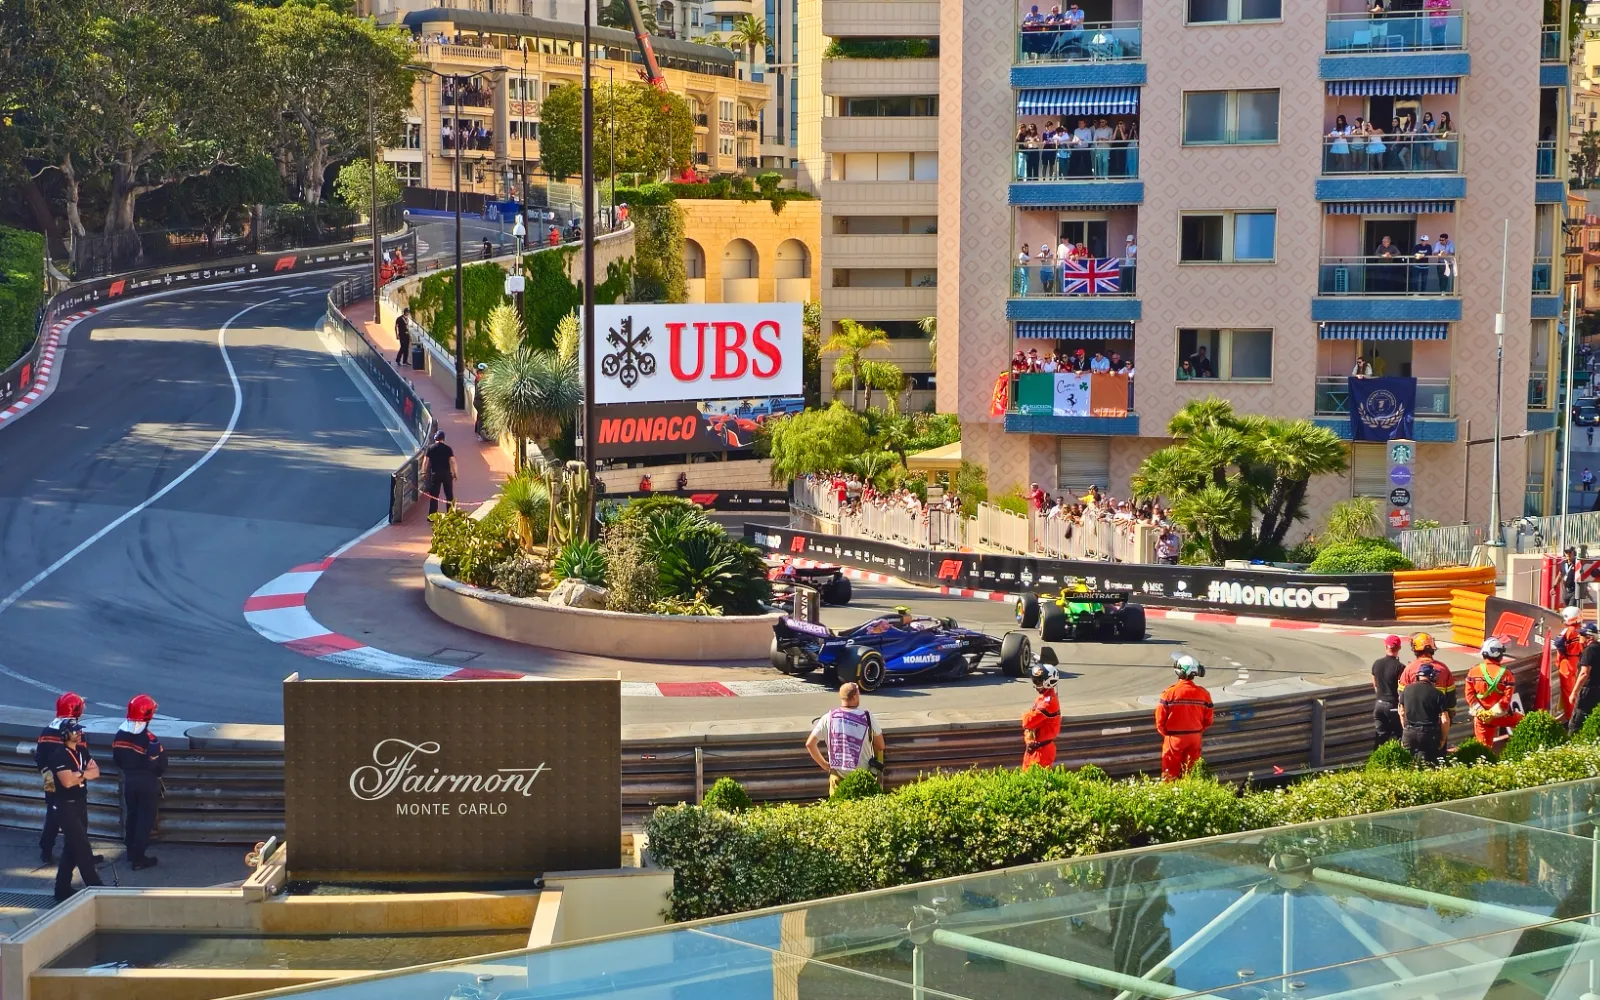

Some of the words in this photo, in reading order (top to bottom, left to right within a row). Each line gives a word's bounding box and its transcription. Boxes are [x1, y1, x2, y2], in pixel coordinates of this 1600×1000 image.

[665, 320, 783, 382] UBS
[598, 415, 697, 444] MONACO
[1207, 580, 1350, 610] #MonacoGP
[903, 653, 941, 664] KOMATSU
[349, 738, 552, 801] Fairmont
[396, 803, 450, 816] MONTE
[458, 803, 508, 816] CARLO
